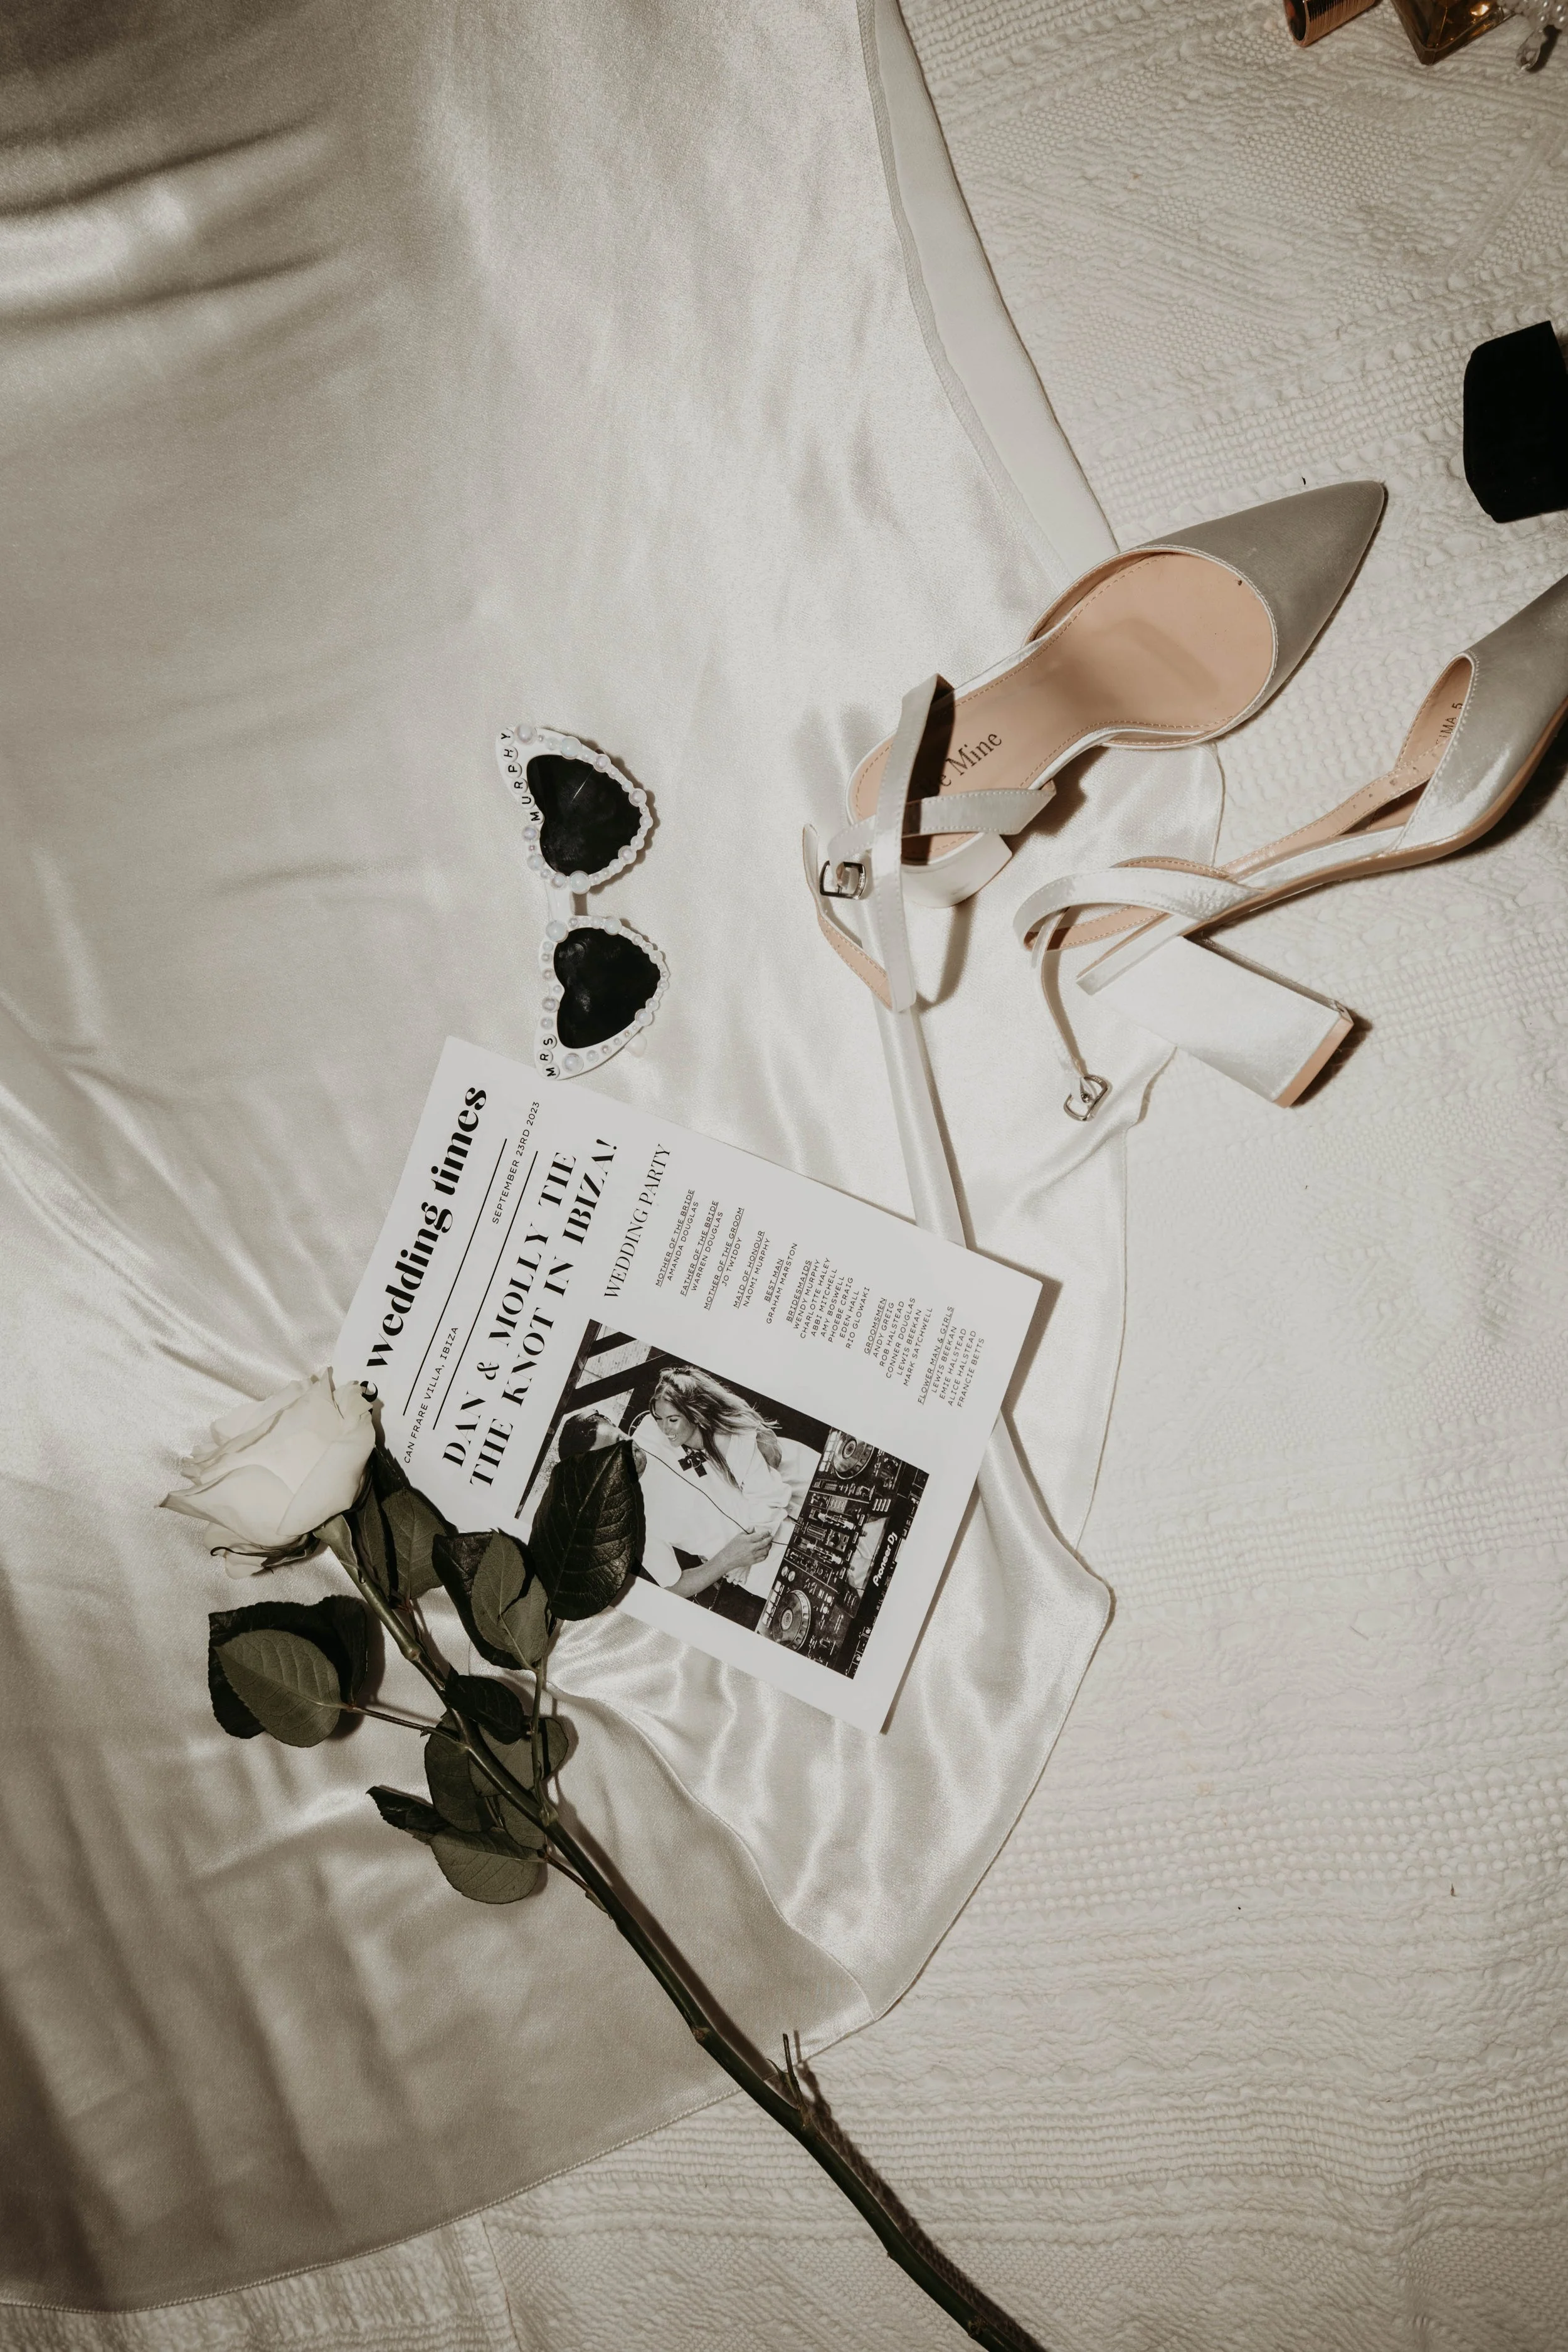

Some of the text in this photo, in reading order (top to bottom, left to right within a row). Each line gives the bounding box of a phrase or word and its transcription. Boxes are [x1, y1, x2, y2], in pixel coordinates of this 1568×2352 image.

[945, 733, 1002, 776] Mine
[501, 733, 556, 1077] MRS MURPHY
[492, 1101, 539, 1224] SEPTEMBER 23RD 2023
[366, 1202, 452, 1367] wedding
[431, 1087, 487, 1195] times
[603, 1143, 670, 1297] WEDDING PARTY
[655, 1189, 694, 1286] MOTHER OF THE BRIDE
[667, 1201, 699, 1281] AMANDA DOUGLAS
[680, 1200, 719, 1296] FATHER OF THE BRIDE
[691, 1211, 723, 1291] WARREN DOUGLAS
[704, 1207, 744, 1310] MOTHER OF THE GROOM
[721, 1237, 742, 1287] JO TWIDDY
[733, 1231, 764, 1308] MAID OF HONOUR
[743, 1238, 770, 1307] NAOMI MURPHY
[764, 1258, 783, 1301] BEST MAN
[766, 1242, 798, 1324] GRAHAM MARSTON
[786, 1260, 811, 1322] BRIDESMAIDS
[793, 1259, 820, 1329] WENDY MURPHY
[442, 1152, 576, 1468] DAN & MOLLY TIE
[469, 1138, 617, 1486] THE KNOT IN IBIZA!
[800, 1258, 830, 1339] CHARLOTTE HALEY
[811, 1269, 837, 1337] ABBI MITCHELL
[820, 1276, 845, 1338] AMY BOSWELL
[828, 1277, 854, 1343] PHOEBE CRAIG
[839, 1291, 859, 1338] EDEN HALL
[845, 1286, 870, 1349] RIO GLOWAKI
[864, 1297, 886, 1354] GROOMSMEN
[872, 1302, 894, 1358] ANDY GREIG
[879, 1301, 904, 1367] ROB HALSTEAD
[886, 1298, 916, 1379] CONNER DOUGLAS
[896, 1309, 922, 1375] LEWIS BEEKAN
[903, 1308, 933, 1386] MARK SATCHWELL
[918, 1368, 933, 1404] FLOWER
[930, 1345, 941, 1366] MAN
[940, 1306, 953, 1335] GIRLS
[931, 1326, 957, 1393] LEWIS BEEKAN
[939, 1328, 967, 1400] EMIE HALSTEAD
[948, 1330, 977, 1406] ALICE HALSTEAD
[957, 1338, 985, 1407] FRANCIE BETTS
[404, 1328, 458, 1464] CAN FRARE VILLA, IBIZA
[872, 1545, 891, 1586] Pioneer
